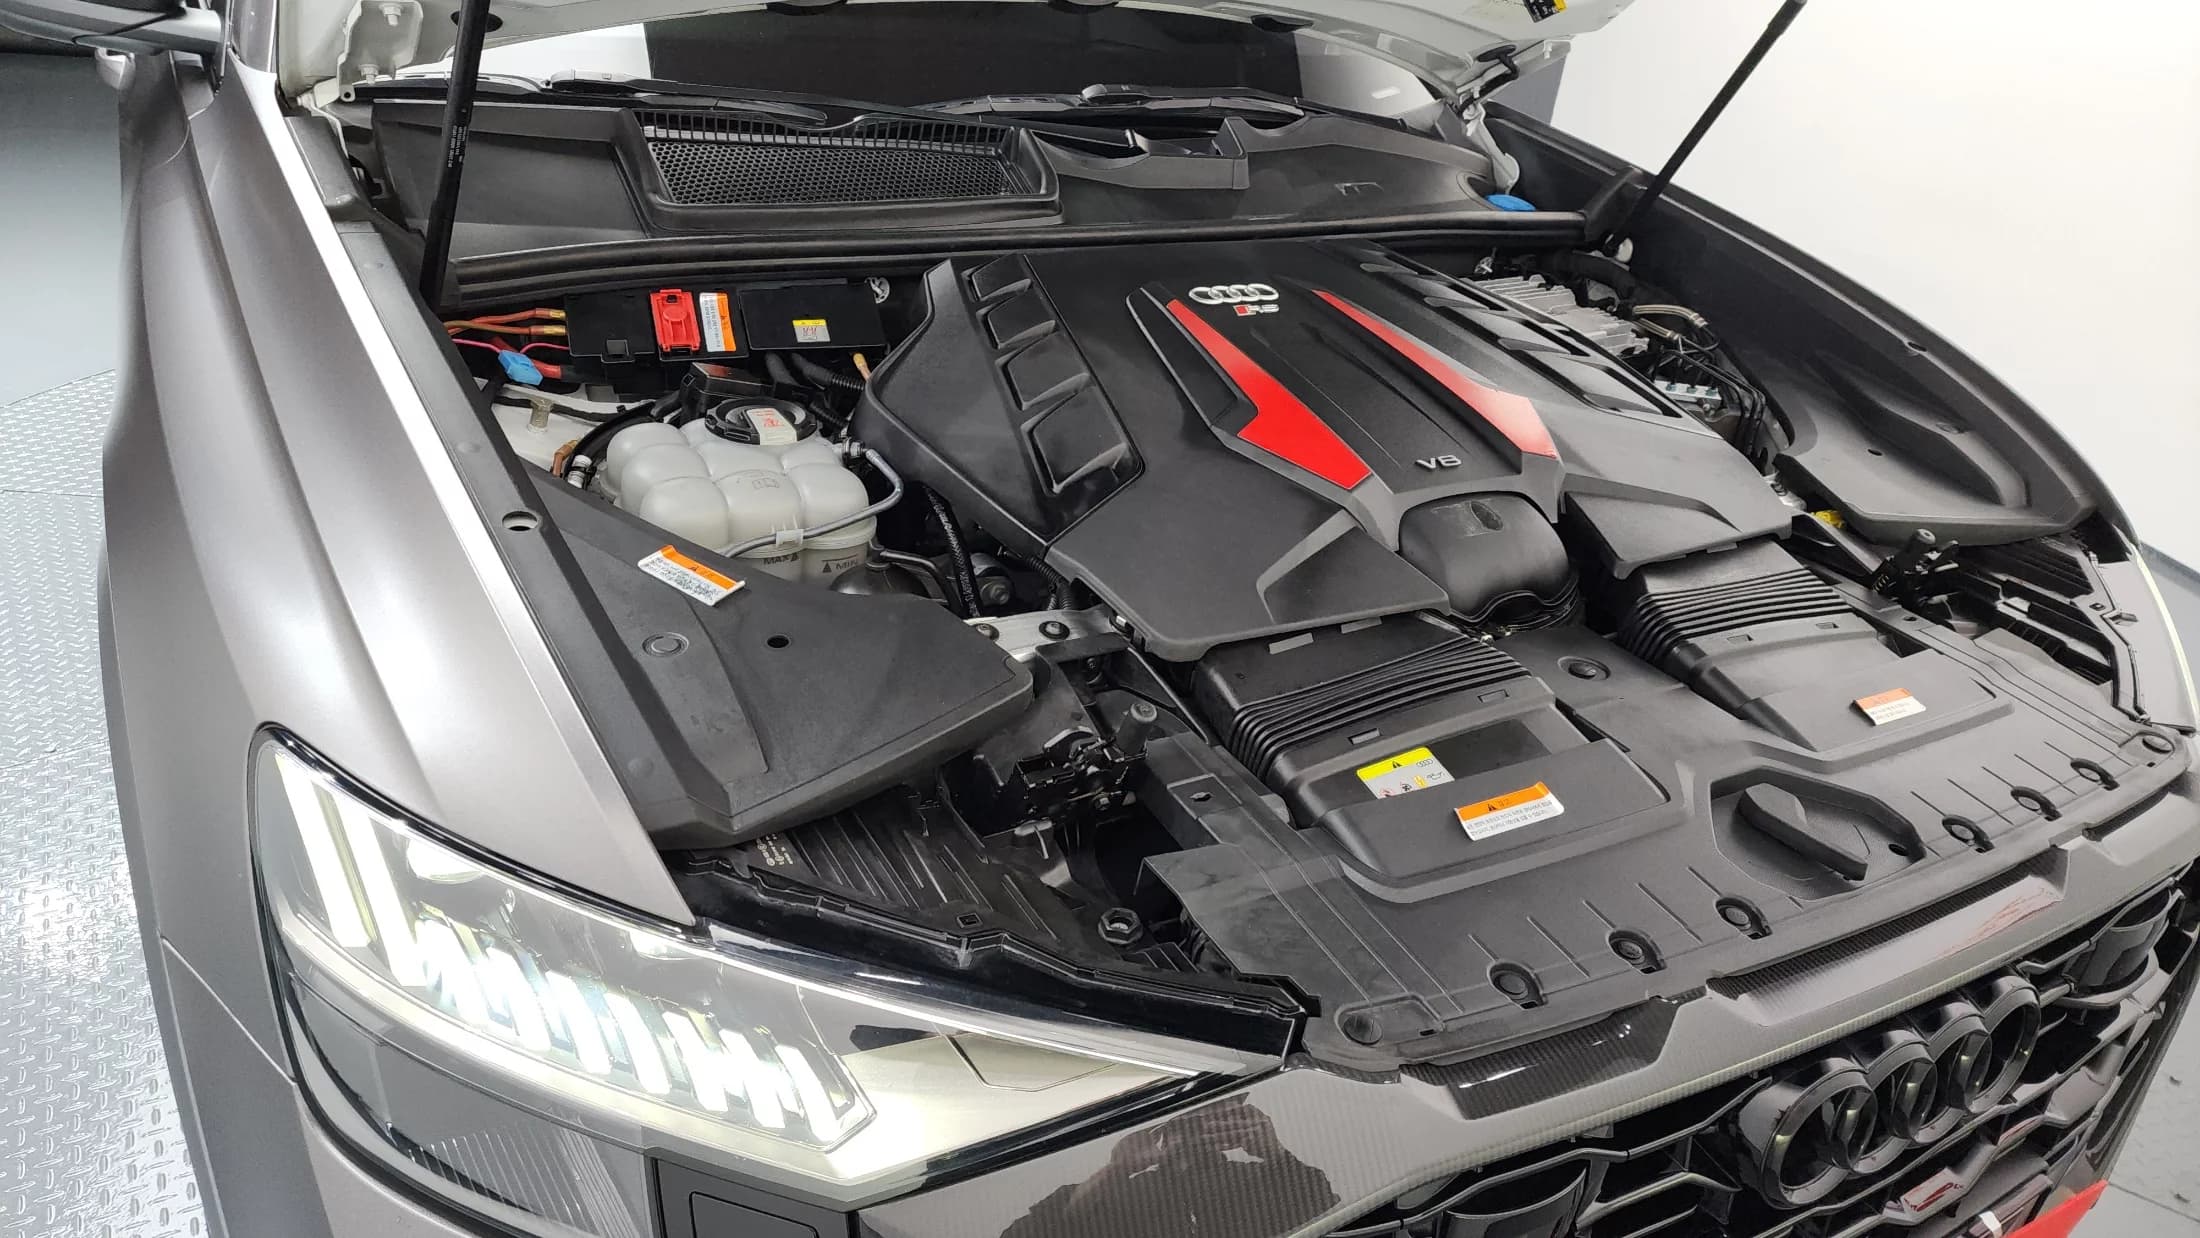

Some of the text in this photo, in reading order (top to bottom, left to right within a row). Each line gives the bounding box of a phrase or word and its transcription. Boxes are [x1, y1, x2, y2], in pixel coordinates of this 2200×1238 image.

[1233, 304, 1279, 317] RS
[1415, 454, 1462, 469] V8
[763, 554, 789, 565] MAX
[835, 559, 859, 570] MIN
